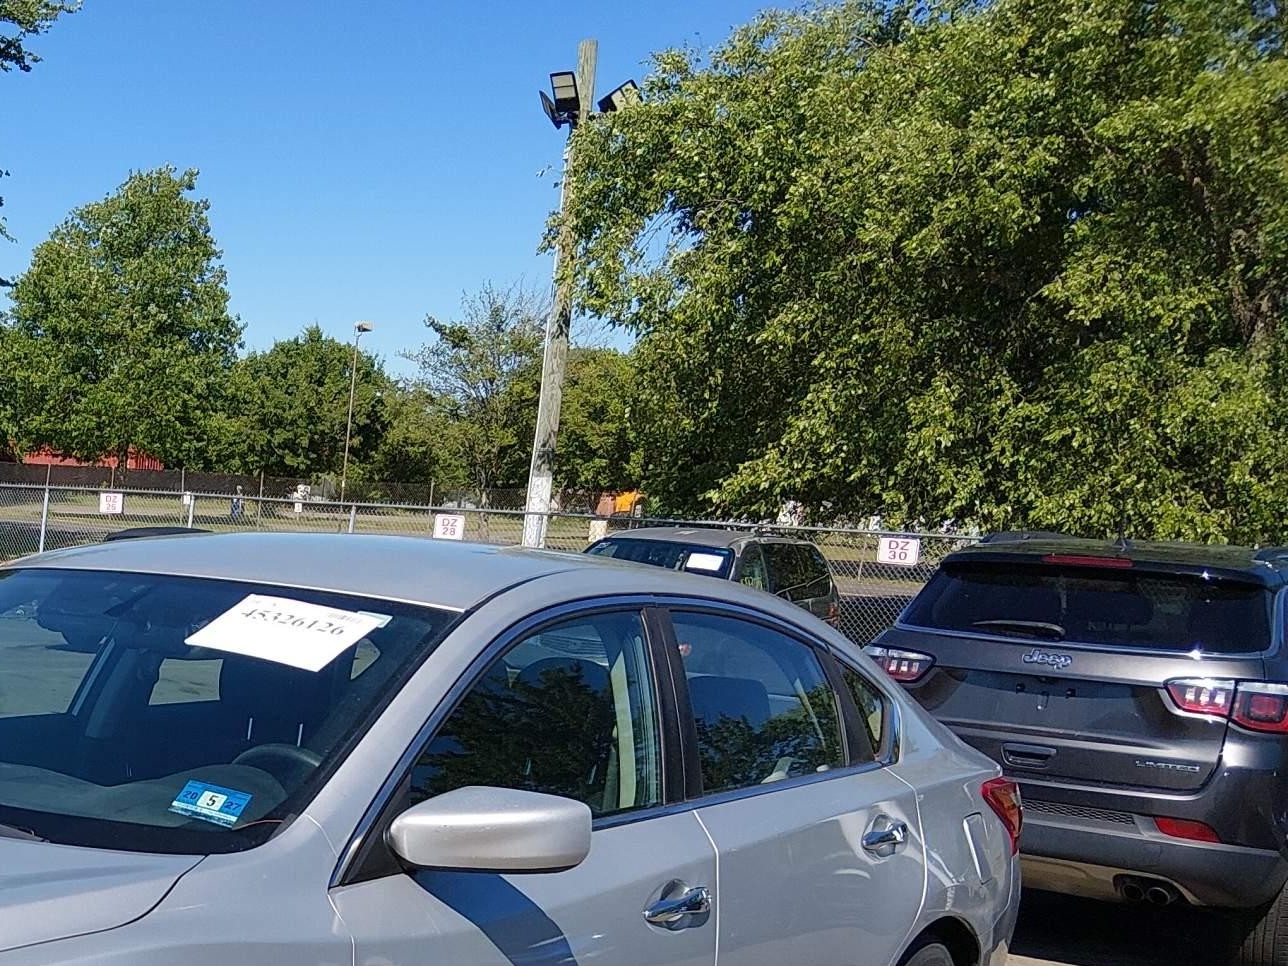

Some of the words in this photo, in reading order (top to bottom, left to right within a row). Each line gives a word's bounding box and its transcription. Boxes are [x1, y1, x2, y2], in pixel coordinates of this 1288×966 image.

[105, 495, 118, 503] DZ
[442, 518, 458, 527] DZ
[442, 527, 456, 536] 28
[888, 540, 911, 551] DZ
[888, 550, 908, 561] 30
[241, 608, 345, 636] 45326126
[1022, 648, 1073, 670] Jeep
[1135, 760, 1201, 773] LIMITED
[182, 790, 199, 800] 20
[206, 794, 218, 807] 5
[223, 801, 242, 811] 27
